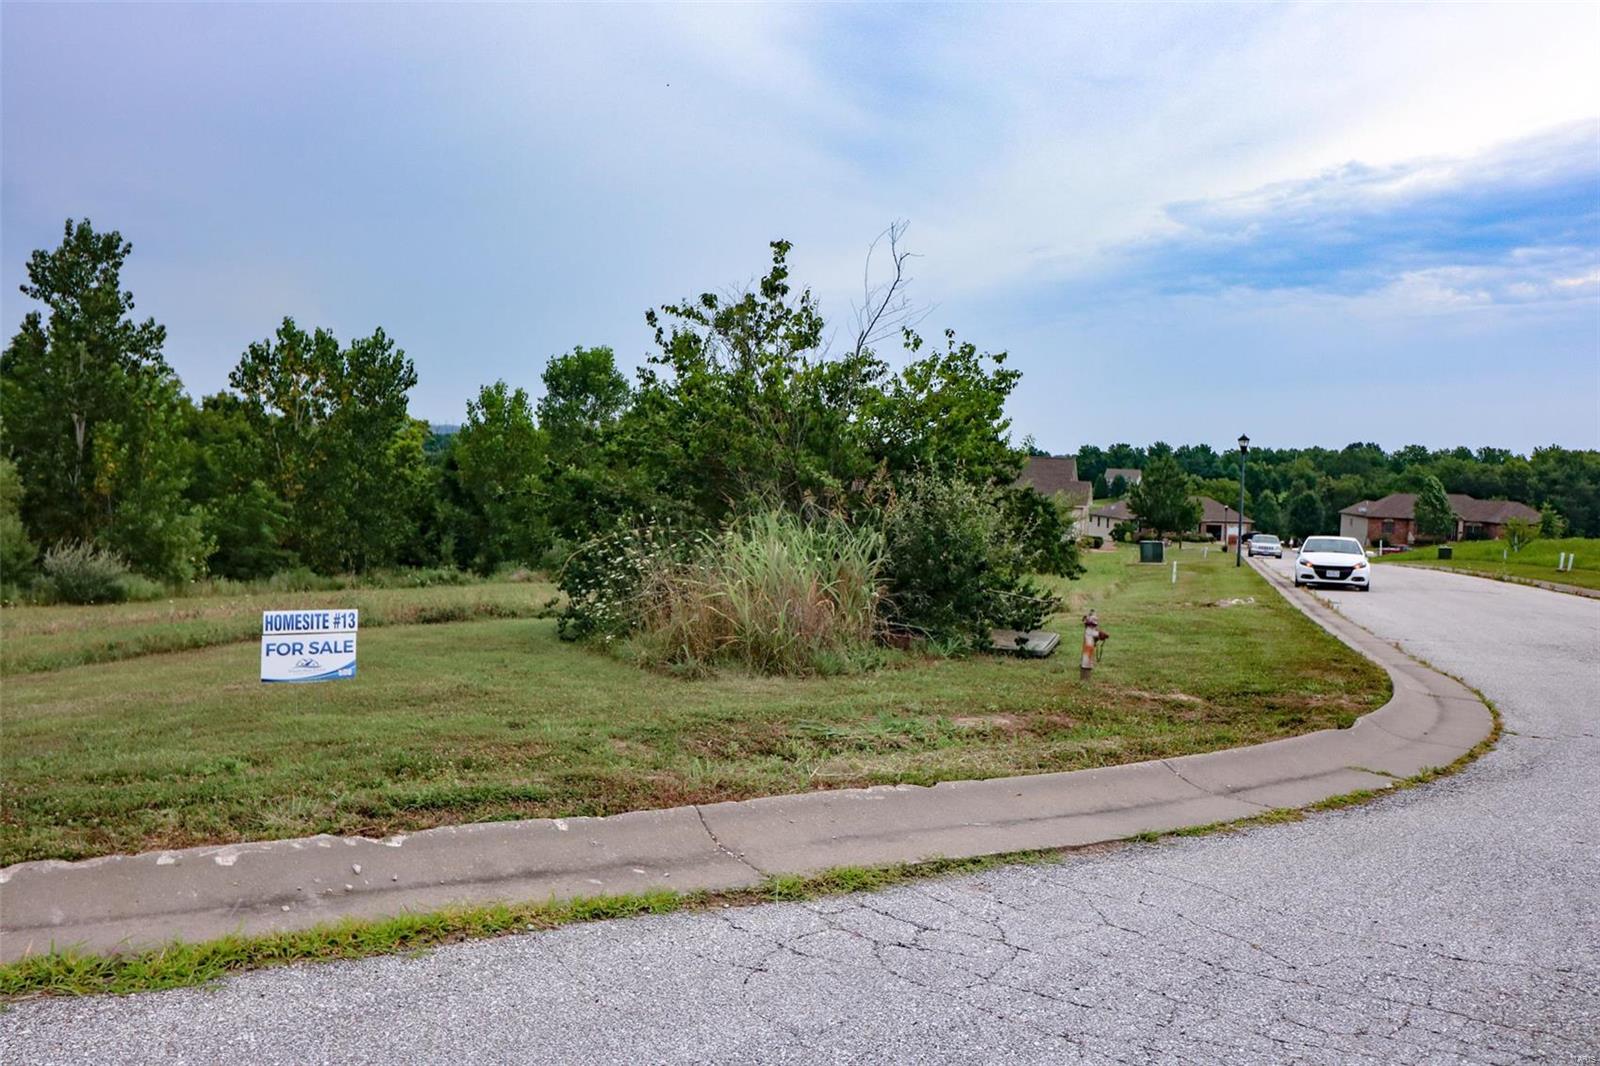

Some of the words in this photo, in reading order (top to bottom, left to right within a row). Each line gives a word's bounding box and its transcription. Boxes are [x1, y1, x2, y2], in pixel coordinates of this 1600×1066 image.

[265, 613, 329, 631] HOMESITE
[333, 612, 356, 629] #13
[266, 642, 304, 656] FOR
[308, 640, 354, 655] SALE
